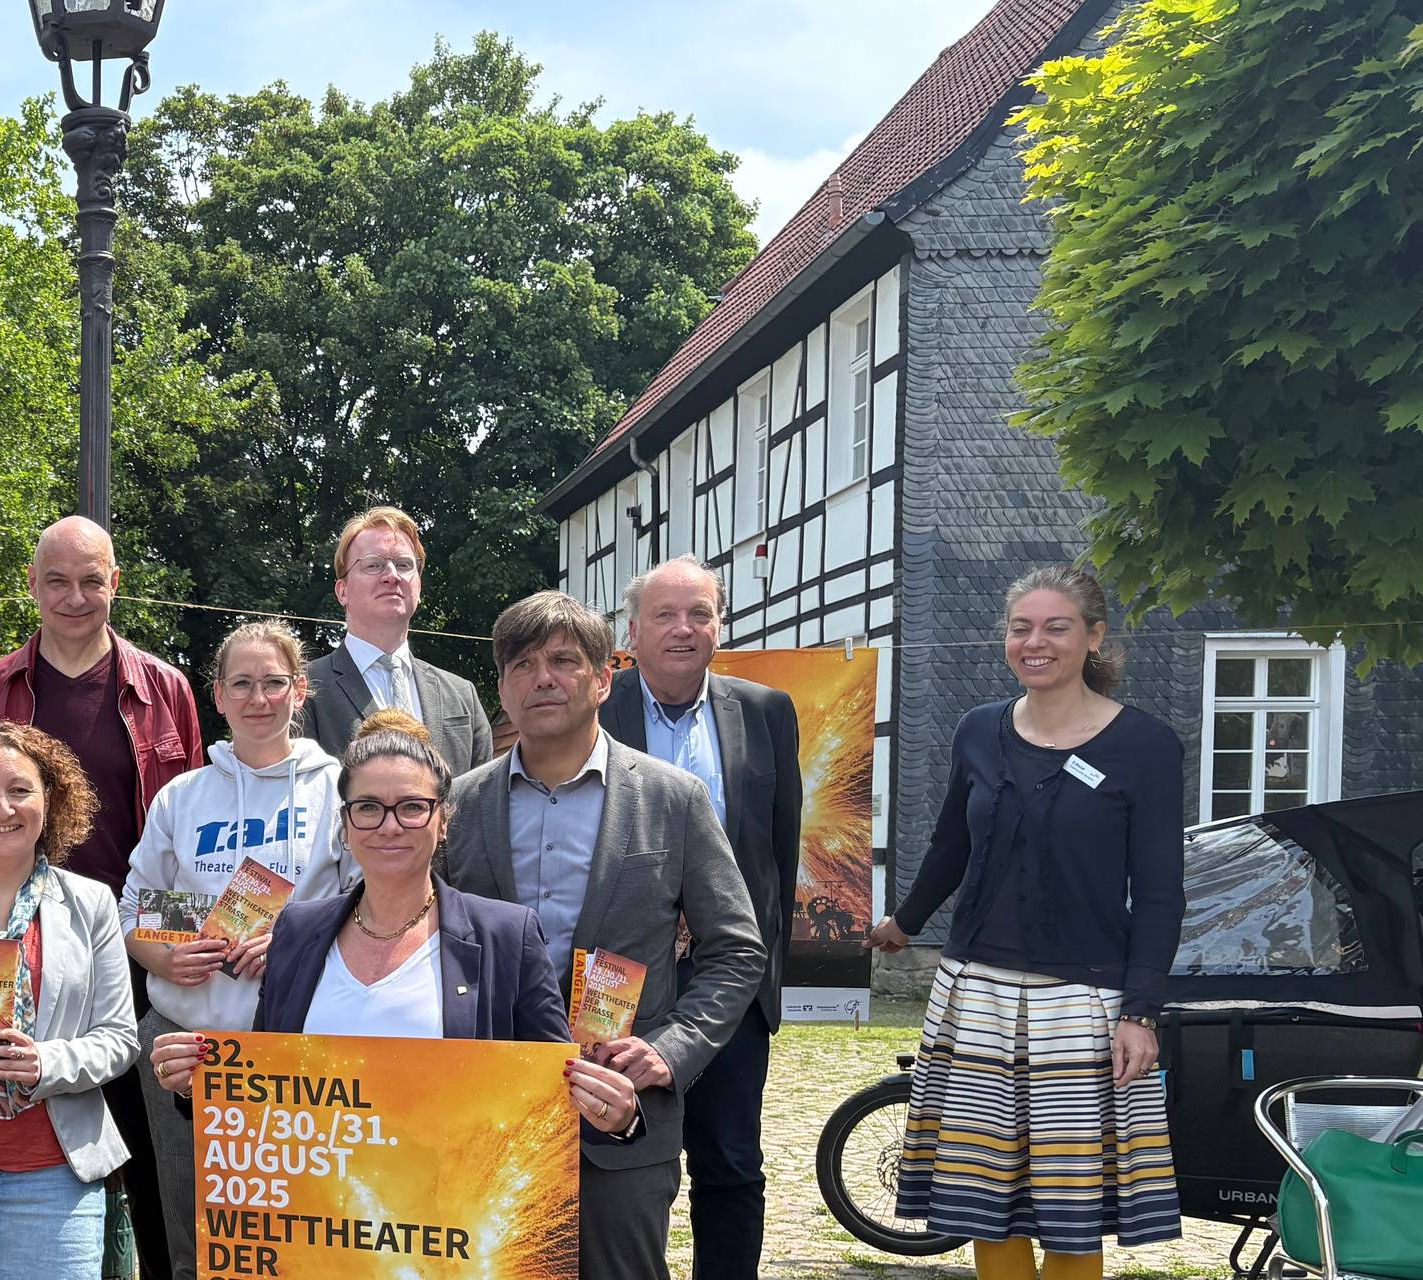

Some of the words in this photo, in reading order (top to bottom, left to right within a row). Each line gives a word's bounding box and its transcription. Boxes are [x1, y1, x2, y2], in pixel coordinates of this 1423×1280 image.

[195, 860, 234, 873] Theate
[269, 862, 301, 875] Flus
[241, 865, 271, 887] FESTIVAL
[232, 877, 263, 896] AUGUST
[218, 900, 249, 922] STRASSE
[222, 895, 237, 906] DER
[225, 888, 274, 921] WELTTHEATER
[137, 929, 174, 942] LANGE
[574, 952, 585, 994] LANGE
[593, 965, 629, 985] 29./30./31.
[596, 959, 625, 975] FESTIVAL
[588, 982, 605, 992] 2025
[590, 973, 619, 988] AUGUST
[585, 995, 599, 1007] DER
[587, 988, 636, 1011] WELTTHEATER
[583, 1003, 614, 1019] STRASSE
[202, 1038, 255, 1069] 32.
[204, 1071, 372, 1109] FESTIVAL
[203, 1104, 398, 1148] 29./30./31.
[204, 1139, 353, 1178] AUGUST
[205, 1174, 290, 1208] 2025
[1219, 1189, 1279, 1204] URBAN
[205, 1208, 470, 1260] WELTTHEATER
[209, 1242, 278, 1276] DER
